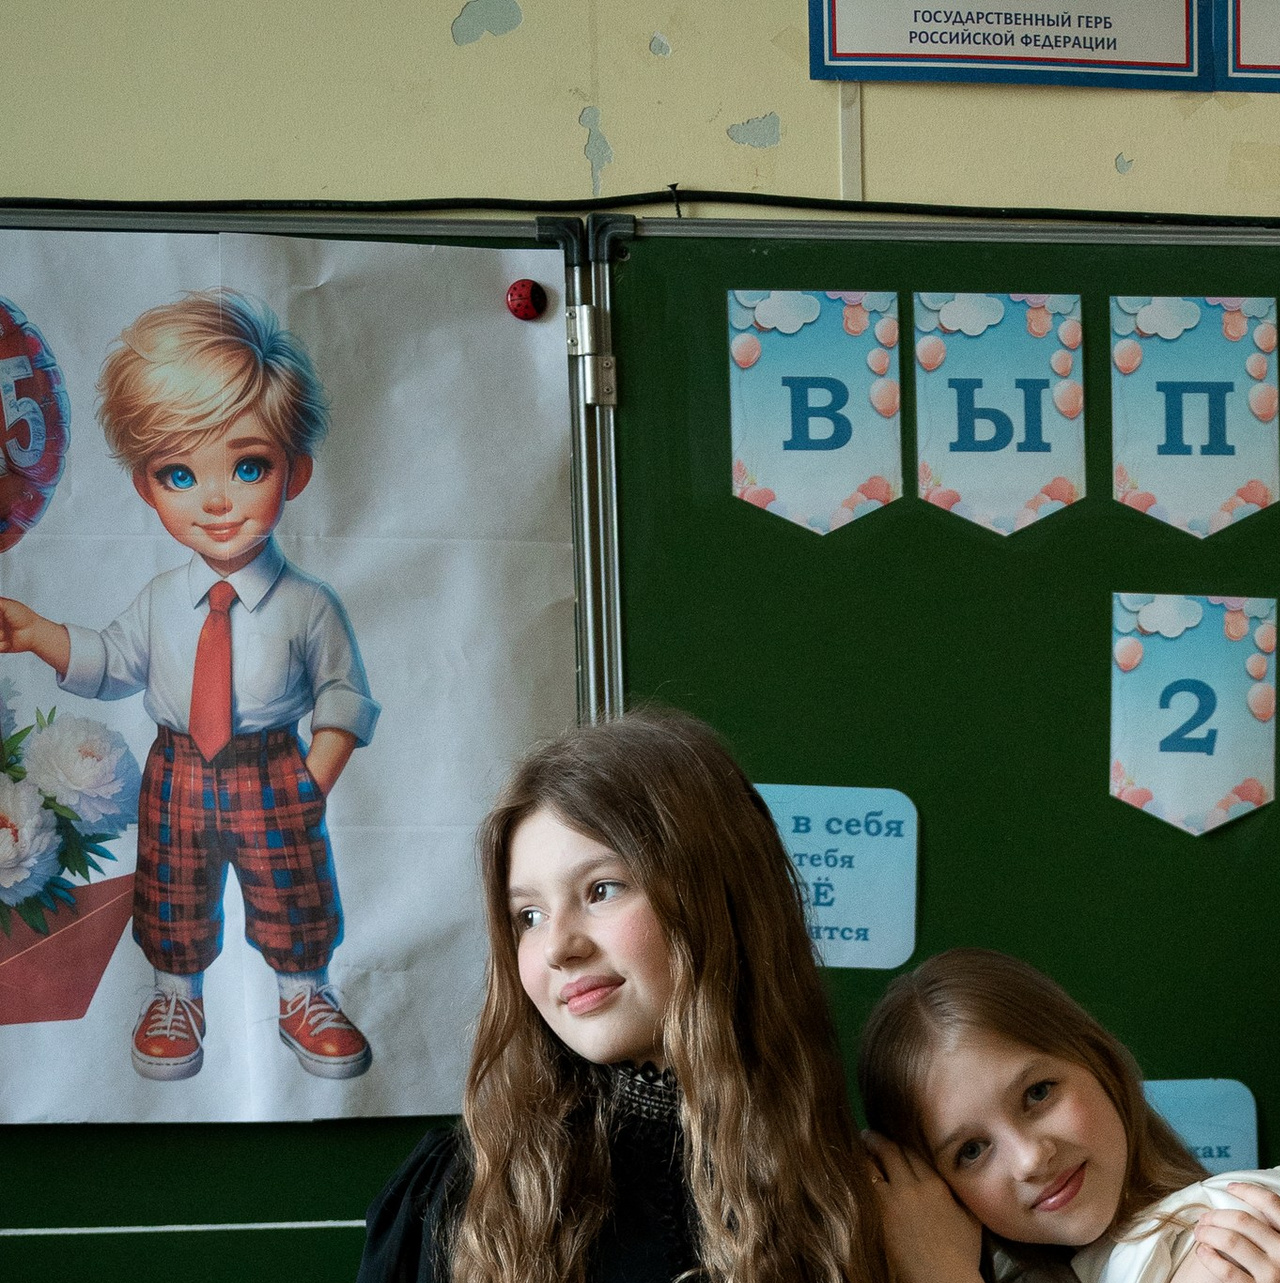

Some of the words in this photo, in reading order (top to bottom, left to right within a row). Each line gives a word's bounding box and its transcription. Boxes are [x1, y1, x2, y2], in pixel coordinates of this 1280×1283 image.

[913, 10, 1072, 28] ГОСУДАРСТВЕННЫЙ
[1077, 15, 1113, 29] ГЕРБ
[908, 29, 1015, 46] РОССИЙСКОЙ
[1020, 34, 1117, 51] ФЕДЕРАЦИИ
[0, 355, 46, 477] 5
[791, 815, 812, 834] в
[825, 810, 905, 838] себя
[793, 848, 855, 869] тебя
